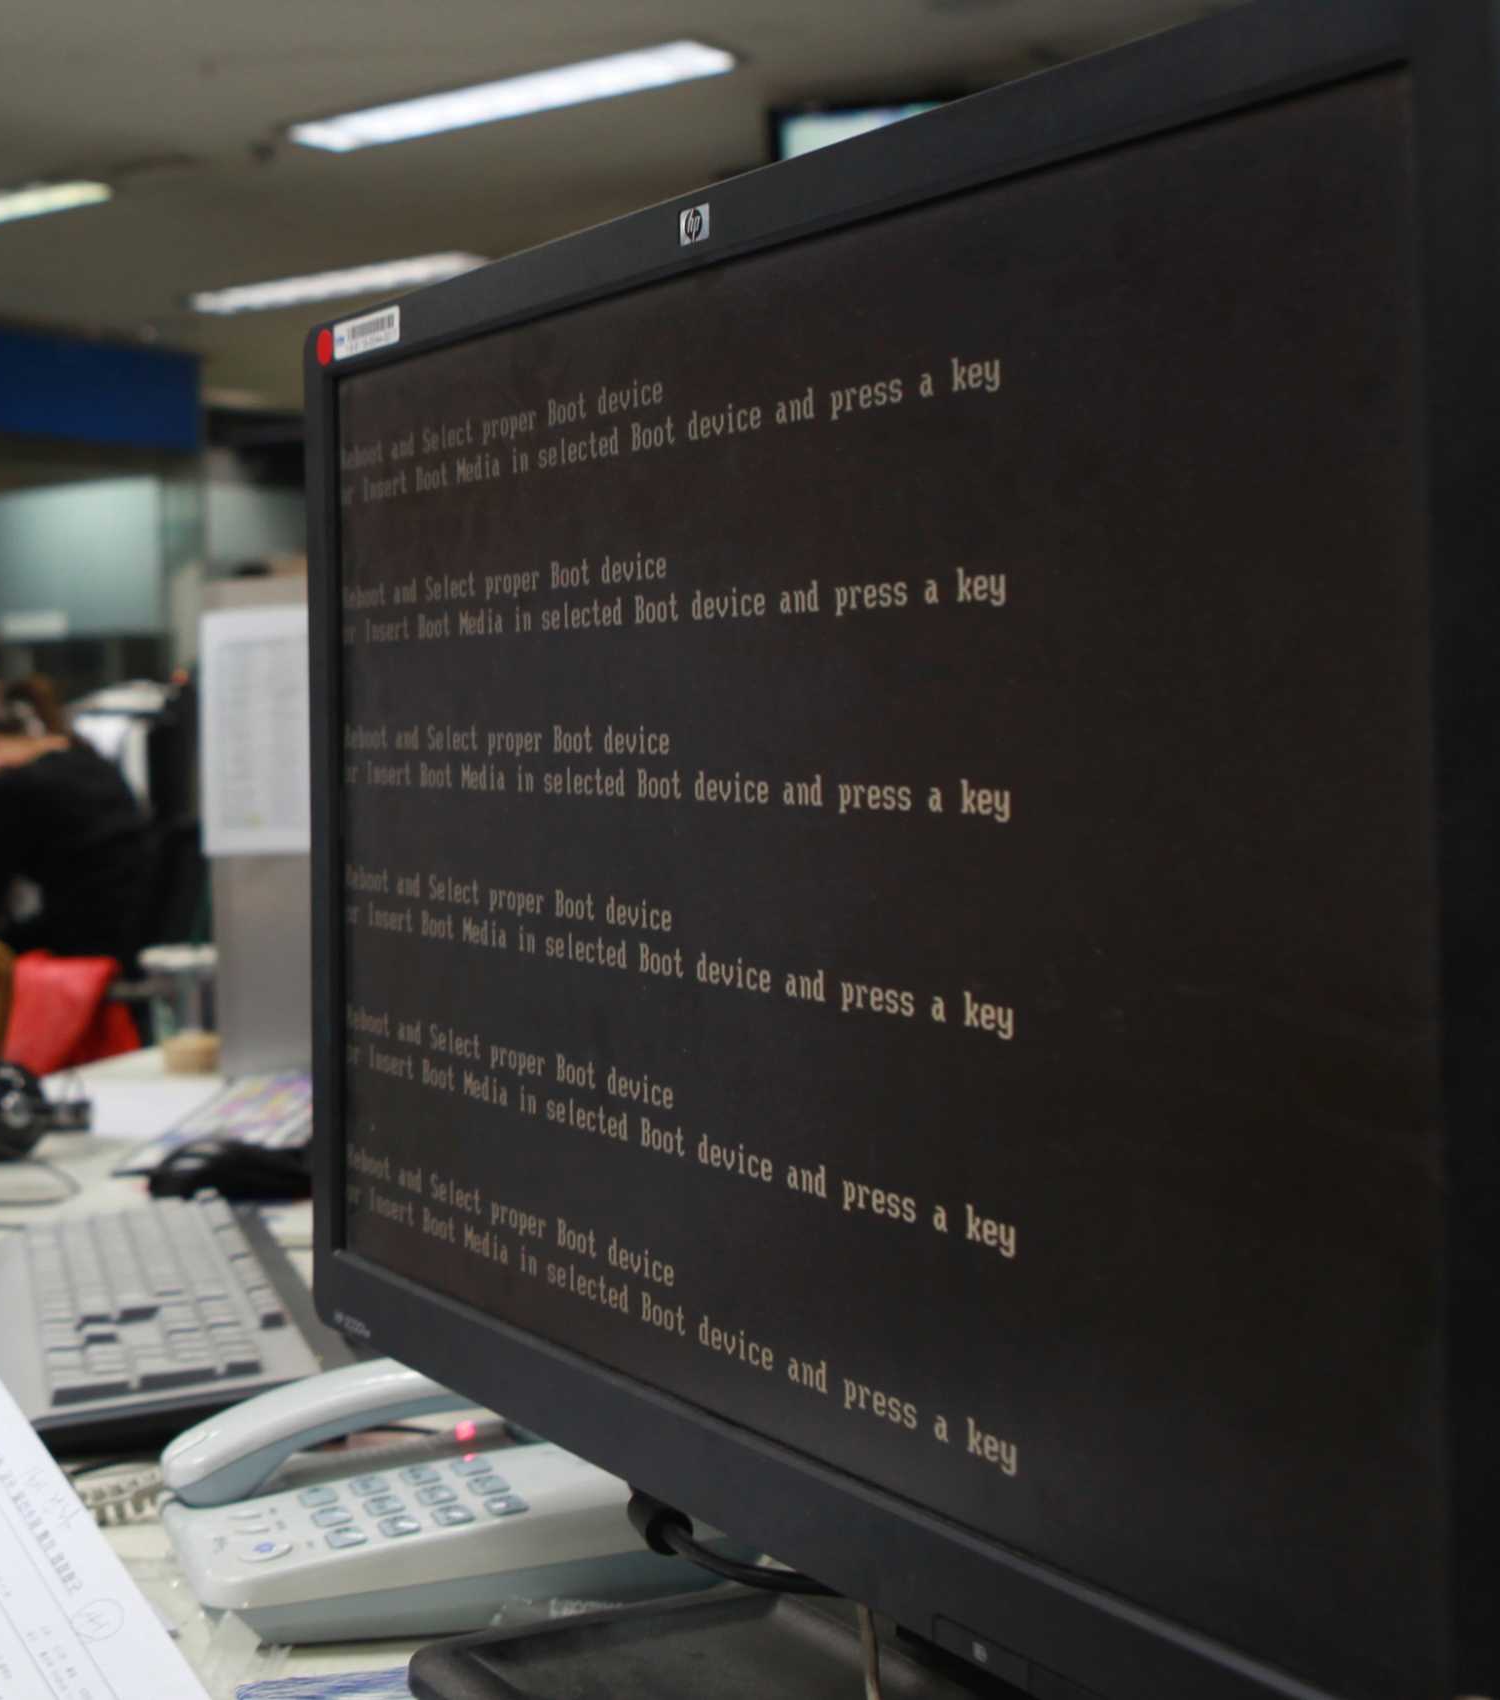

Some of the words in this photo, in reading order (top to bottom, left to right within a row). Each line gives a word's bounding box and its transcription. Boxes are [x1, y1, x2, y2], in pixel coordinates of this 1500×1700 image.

[363, 471, 407, 502] Insert
[416, 463, 448, 491] Boot
[456, 455, 500, 483] Media
[512, 448, 528, 473] in
[538, 427, 619, 468] selected
[631, 416, 675, 451] Boot
[688, 403, 761, 440] device
[776, 387, 814, 424] and
[830, 379, 903, 420] press
[919, 373, 933, 397] a
[951, 358, 1000, 392] key
[391, 432, 414, 460] and
[422, 418, 473, 453] Select
[483, 411, 536, 445] proper
[548, 392, 586, 426] Boot
[598, 379, 663, 415] device
[366, 617, 409, 643] Insert
[418, 613, 450, 639] Boot
[459, 609, 503, 635] Media
[514, 607, 531, 632] in
[542, 597, 622, 630] selected
[635, 592, 678, 624] Boot
[692, 587, 765, 620] device
[780, 580, 819, 613] and
[835, 582, 908, 616] press
[924, 579, 939, 604] a
[957, 567, 1006, 606] key
[394, 578, 417, 604] and
[425, 571, 475, 601] Select
[485, 571, 539, 600] proper
[551, 558, 589, 589] Boot
[601, 552, 666, 584] device
[396, 725, 419, 750] and
[427, 724, 478, 751] Select
[488, 732, 542, 756] proper
[553, 725, 592, 753] Boot
[604, 725, 669, 755] device
[367, 760, 411, 786] Insert
[420, 762, 452, 788] Boot
[461, 764, 505, 790] Media
[516, 765, 534, 792] in
[544, 767, 625, 797] selected
[638, 769, 681, 799] Boot
[695, 771, 769, 804] device
[783, 774, 823, 806] and
[839, 784, 911, 814] press
[928, 787, 942, 812] a
[961, 779, 1010, 822] key
[397, 872, 420, 897] and
[429, 874, 479, 905] Select
[489, 889, 544, 916] proper
[555, 889, 594, 920] Boot
[606, 896, 672, 932] device
[368, 902, 413, 933] Insert
[421, 910, 454, 940] Boot
[463, 918, 506, 948] Media
[518, 926, 535, 954] in
[546, 933, 627, 969] selected
[640, 943, 683, 978] Boot
[697, 952, 771, 993] device
[786, 970, 825, 1002] and
[841, 982, 914, 1017] press
[931, 996, 946, 1022] a
[964, 991, 1013, 1040] key
[398, 1021, 421, 1045] and
[430, 1024, 480, 1059] Select
[491, 1046, 545, 1076] proper
[556, 1054, 595, 1089] Boot
[608, 1067, 673, 1109] device
[369, 1045, 414, 1080] Insert
[422, 1059, 455, 1091] Boot
[464, 1071, 507, 1106] Media
[519, 1086, 536, 1114] in
[547, 1099, 628, 1141] selected
[641, 1117, 685, 1157] Boot
[698, 1134, 772, 1182] device
[787, 1165, 826, 1198] and
[843, 1181, 916, 1223] press
[933, 1205, 947, 1232] a
[966, 1204, 1015, 1258] key
[398, 1168, 422, 1193] and
[430, 1173, 481, 1215] Select
[491, 1202, 546, 1238] proper
[557, 1218, 596, 1258] Boot
[608, 1238, 674, 1286] device
[369, 1187, 414, 1227] Insert
[423, 1208, 455, 1243] Boot
[464, 1224, 508, 1264] Media
[520, 1246, 537, 1276] in
[547, 1264, 629, 1313] selected
[642, 1292, 685, 1336] Boot
[699, 1315, 773, 1371] device
[788, 1358, 827, 1393] and
[844, 1379, 917, 1429] press
[934, 1415, 948, 1442] a
[967, 1417, 1017, 1476] key
